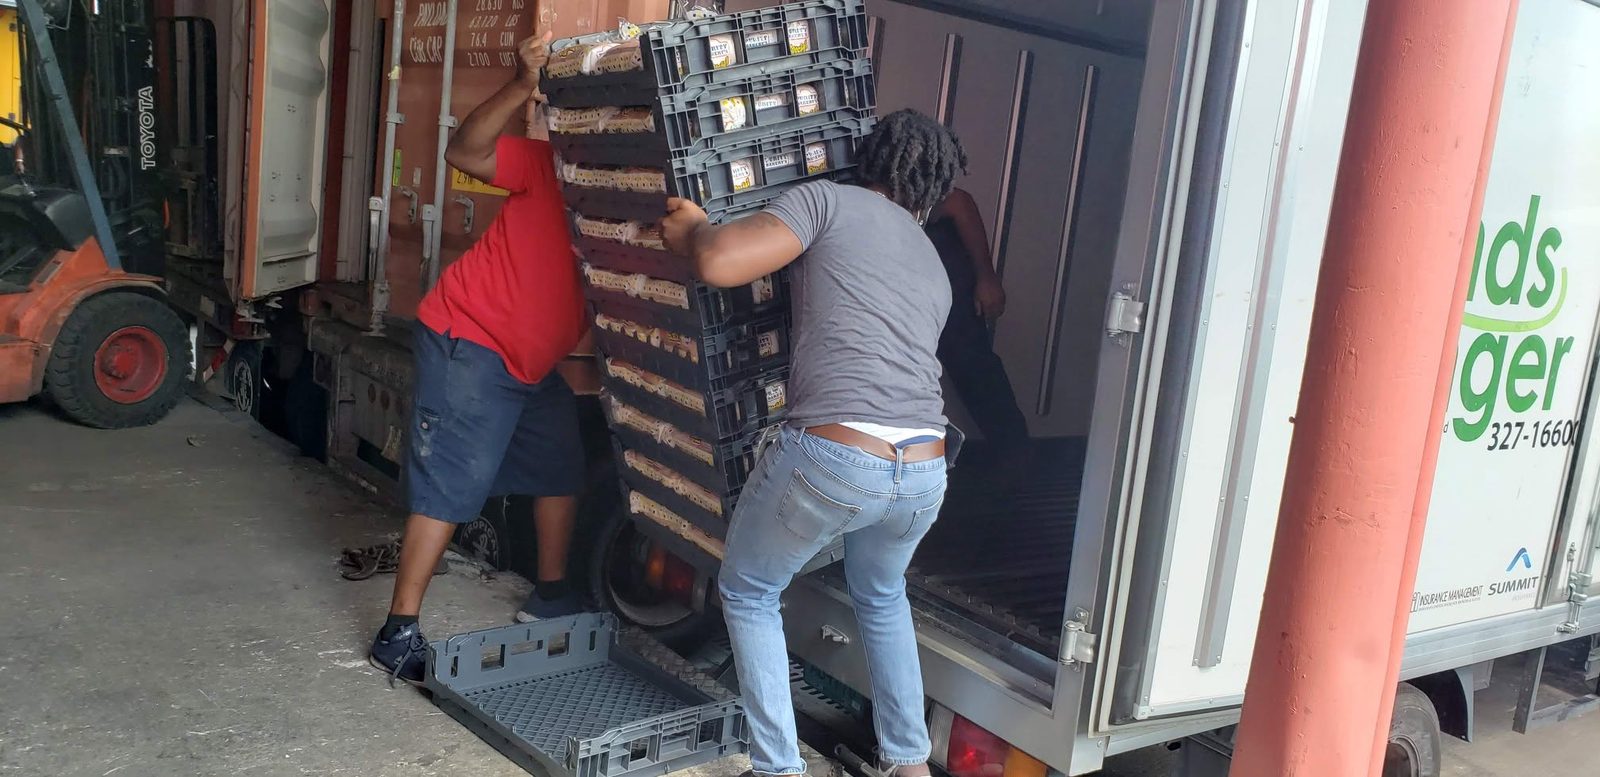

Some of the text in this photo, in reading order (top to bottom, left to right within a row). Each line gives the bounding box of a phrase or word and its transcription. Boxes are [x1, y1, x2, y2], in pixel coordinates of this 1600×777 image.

[138, 85, 156, 170] TOYOTA
[1450, 332, 1575, 442] ger
[1488, 576, 1539, 596] SUMMIT
